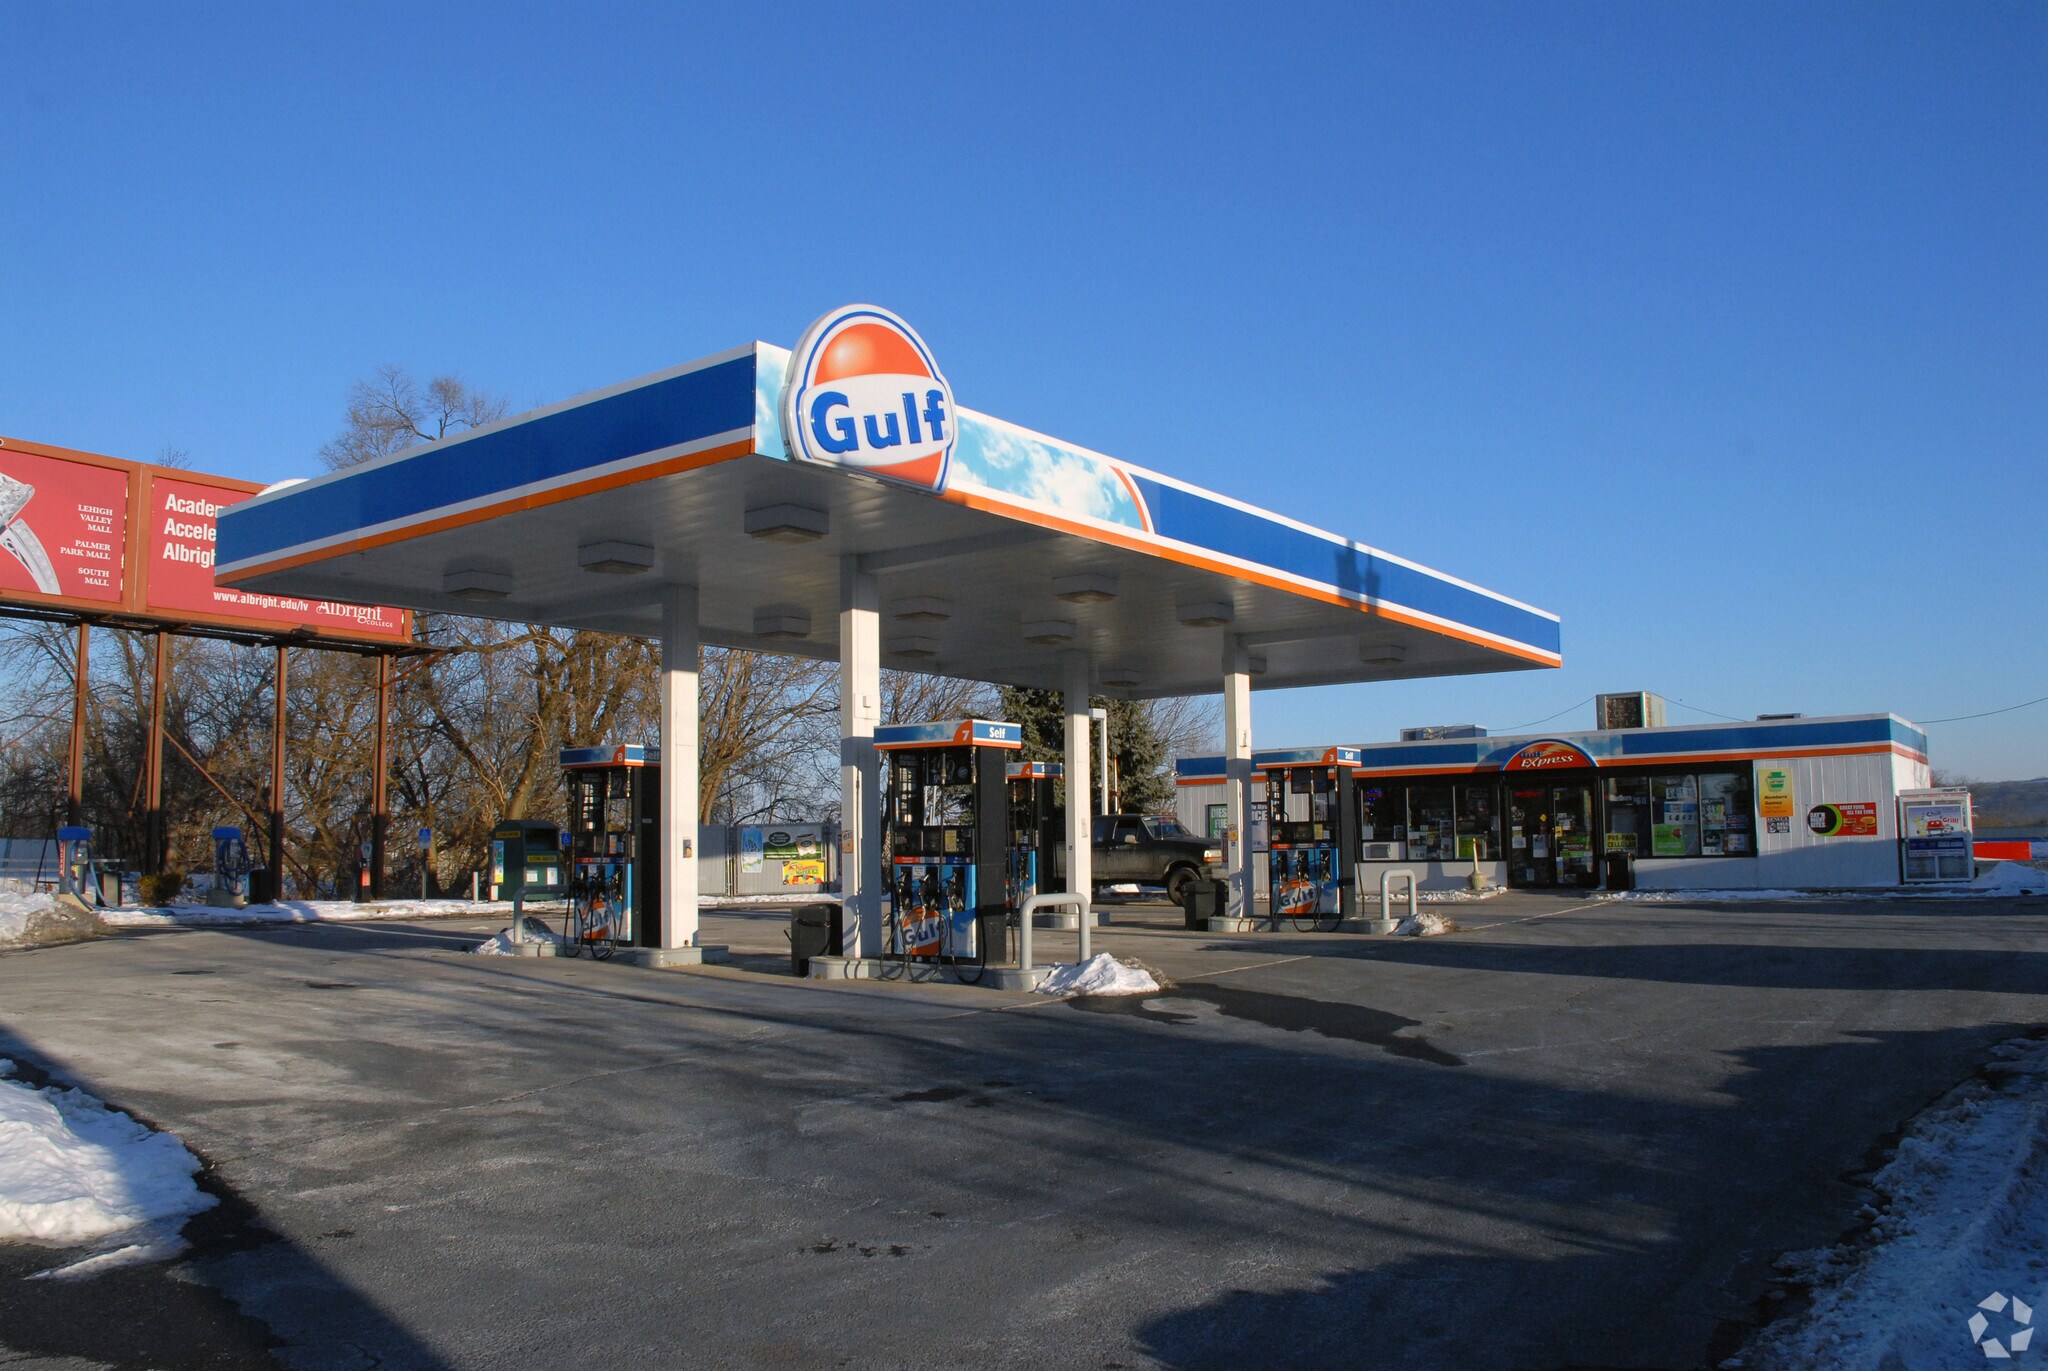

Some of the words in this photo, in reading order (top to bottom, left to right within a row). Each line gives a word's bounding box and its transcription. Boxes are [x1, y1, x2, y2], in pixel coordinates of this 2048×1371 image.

[811, 389, 945, 454] Gulf
[78, 504, 113, 516] LEHIGH
[80, 513, 113, 525] VALLEY
[87, 523, 112, 534] MALL
[75, 539, 111, 551] PALMER
[60, 546, 84, 557] PARK
[86, 550, 111, 560] MALL
[77, 566, 110, 578] SOUTH
[84, 576, 109, 587] MALL
[213, 591, 309, 612] www.albright.edu/lv
[316, 600, 382, 624] Albright
[366, 618, 393, 629] COLLEGE
[962, 729, 970, 741] 7
[989, 726, 1006, 740] Self
[1329, 754, 1335, 763] 3
